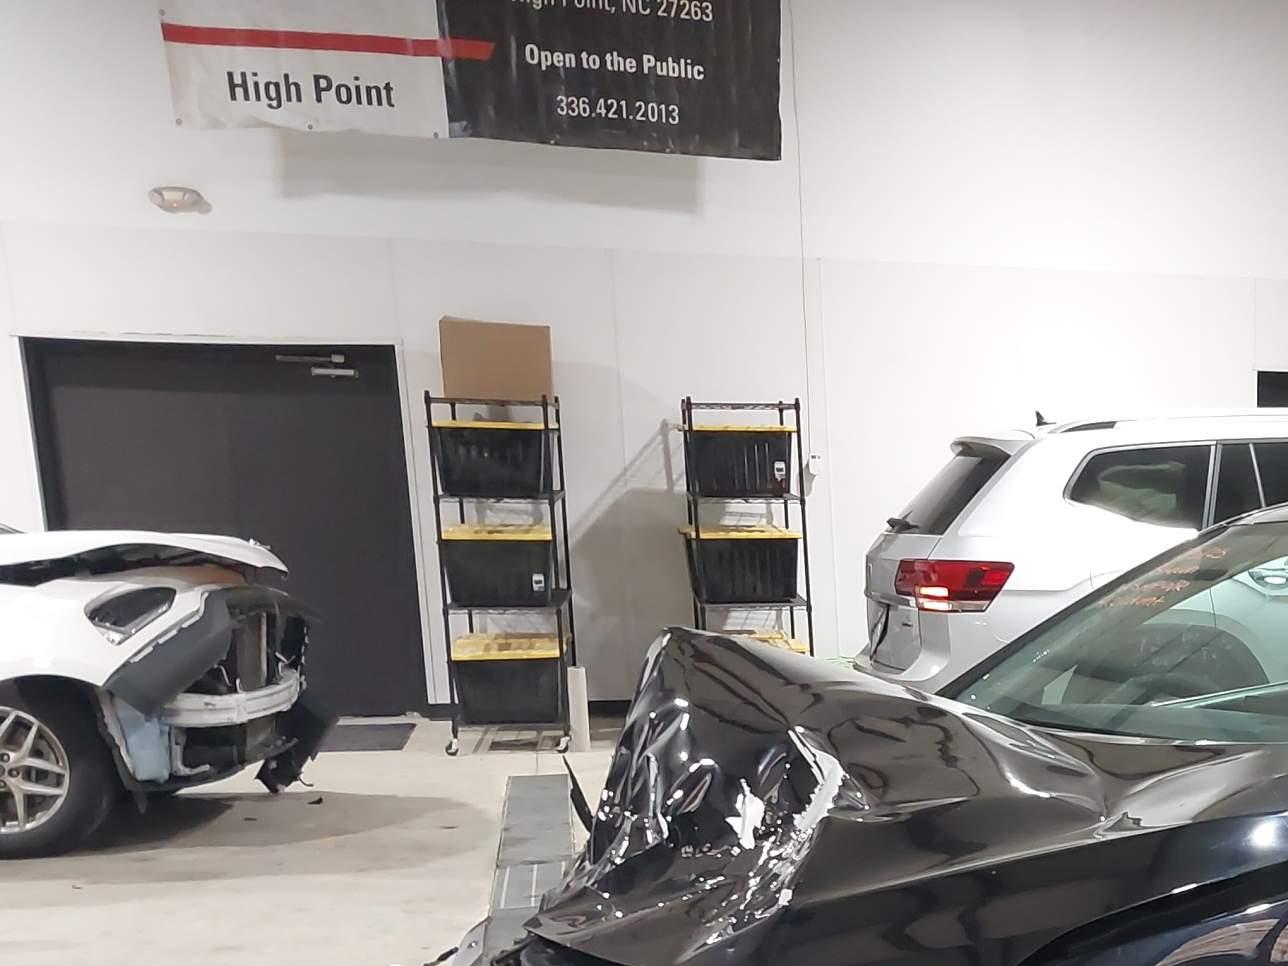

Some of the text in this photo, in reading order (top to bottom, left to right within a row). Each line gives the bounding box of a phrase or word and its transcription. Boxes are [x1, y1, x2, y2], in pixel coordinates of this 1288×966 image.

[622, 0, 651, 15] NC
[657, 0, 713, 21] 27263
[525, 44, 705, 80] Open to the Public
[227, 71, 395, 110] High Point
[556, 95, 680, 125] 336.421.2013
